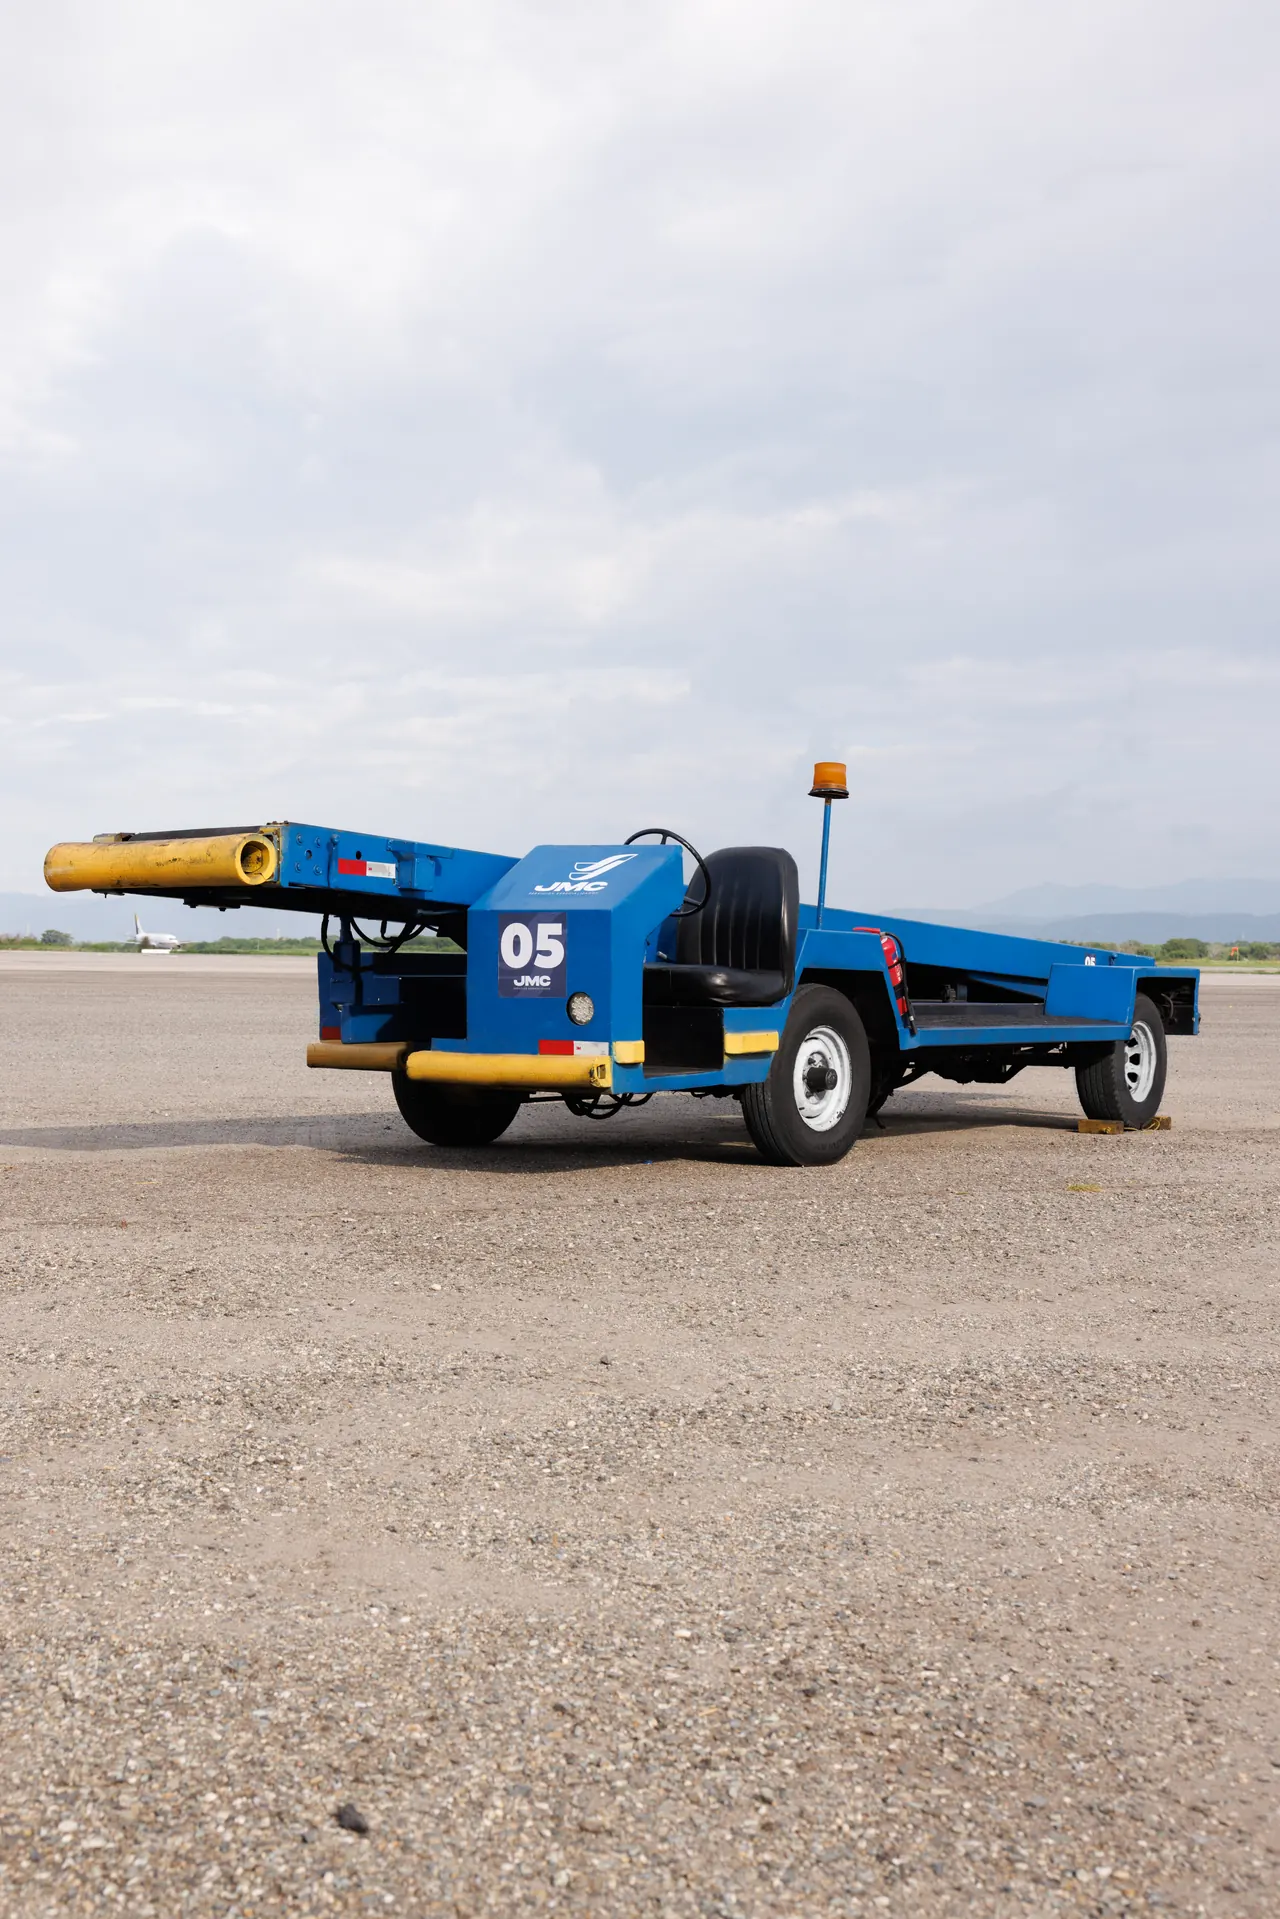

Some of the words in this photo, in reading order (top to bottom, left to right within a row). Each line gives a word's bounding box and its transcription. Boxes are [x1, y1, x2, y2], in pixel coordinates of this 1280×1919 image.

[534, 881, 609, 892] JMC
[500, 922, 565, 969] 05
[513, 975, 552, 987] JMC
